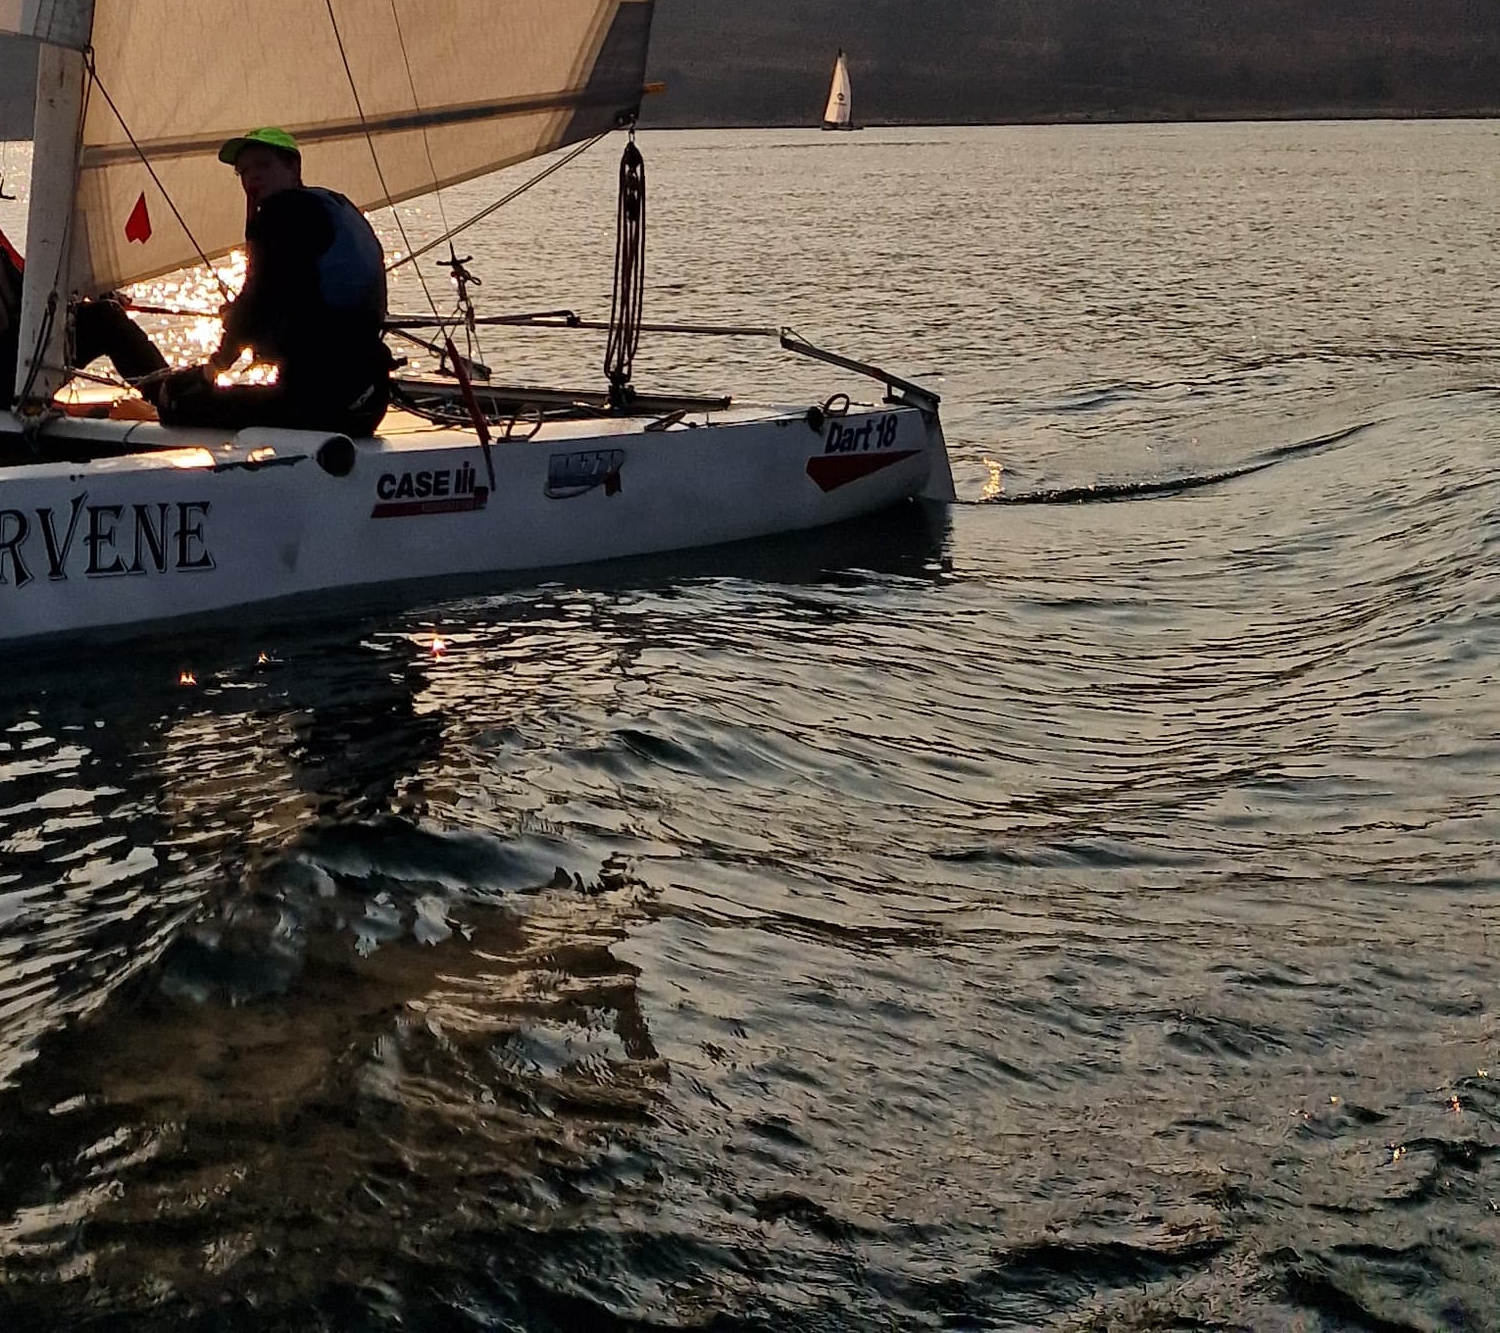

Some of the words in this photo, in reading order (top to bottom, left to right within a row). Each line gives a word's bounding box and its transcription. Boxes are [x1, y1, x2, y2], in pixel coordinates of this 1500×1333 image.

[825, 419, 875, 454] Dart
[876, 414, 899, 449] 18
[377, 469, 451, 500] CASE
